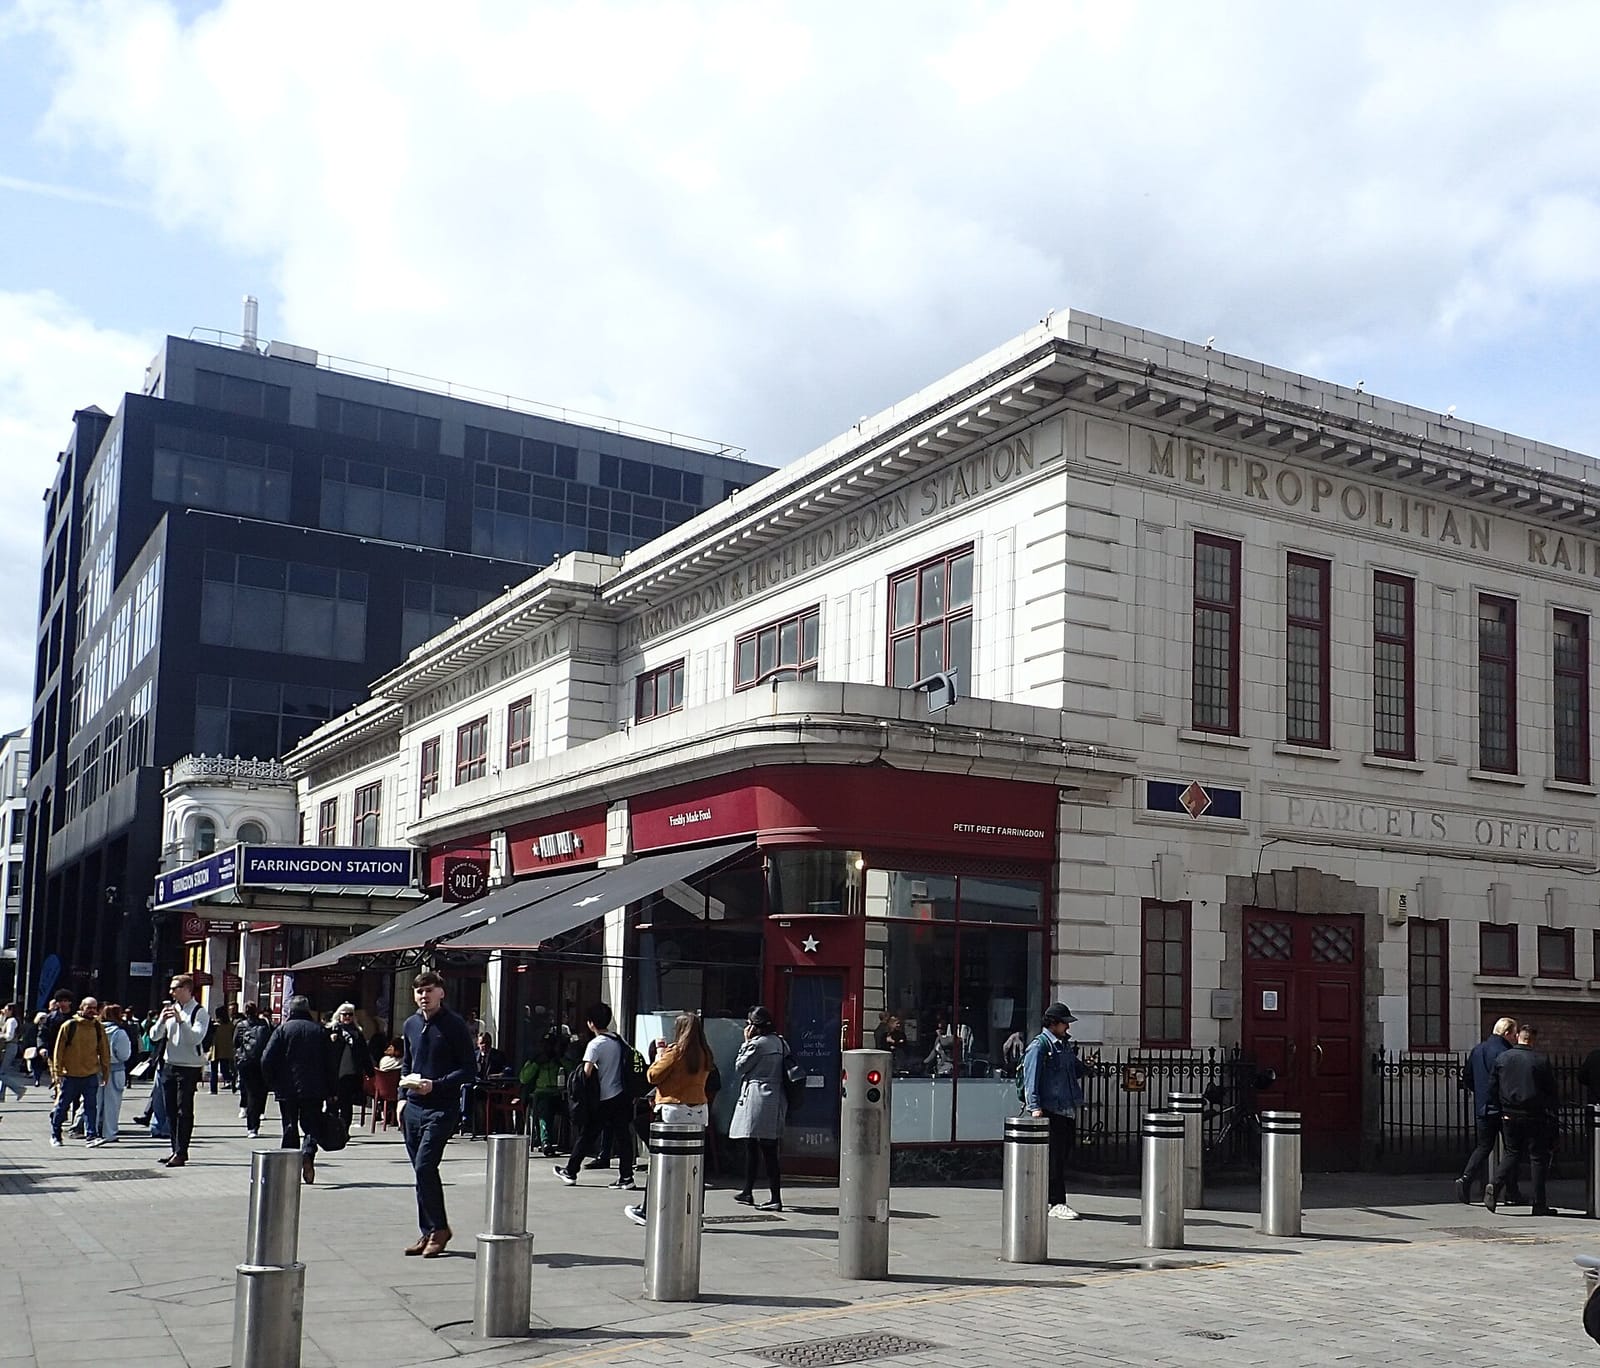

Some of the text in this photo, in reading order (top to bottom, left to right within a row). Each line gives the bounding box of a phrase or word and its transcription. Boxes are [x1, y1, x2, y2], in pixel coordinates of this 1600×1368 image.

[1147, 433, 1600, 579] METROPOLITAN RAI
[628, 431, 1035, 647] FARRINGDON & HIGH HOLBORN STATION
[686, 811, 699, 823] Made
[699, 808, 711, 821] Food
[953, 823, 1045, 838] PETIT PRET FARRINGDON
[1286, 797, 1582, 853] PARCELS OFFICE
[250, 859, 403, 873] FARRINGDON STATION
[455, 874, 478, 888] PRET
